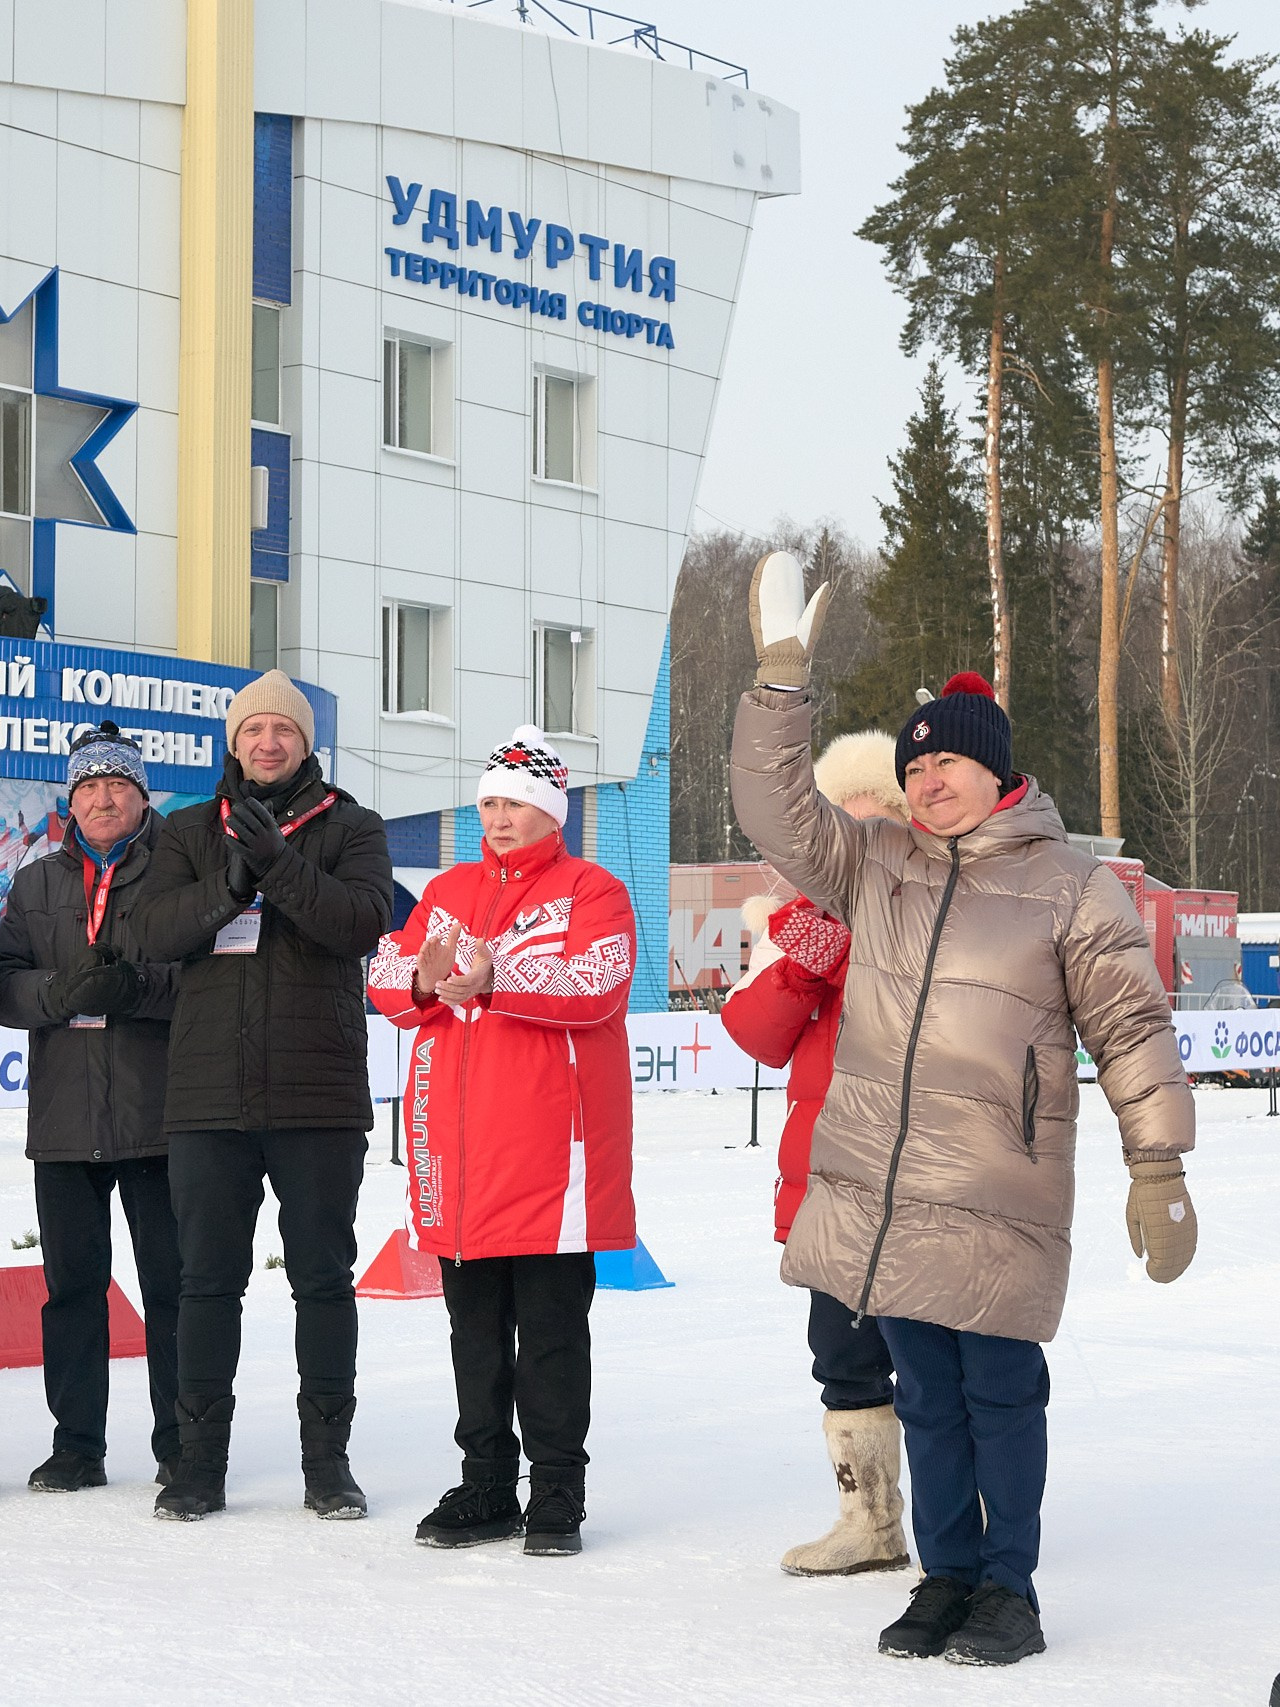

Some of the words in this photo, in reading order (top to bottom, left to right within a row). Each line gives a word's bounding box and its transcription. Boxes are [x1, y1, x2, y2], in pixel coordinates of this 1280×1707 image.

[385, 174, 676, 302] УДМУРТИЯ
[384, 246, 567, 320] ТЕРРИТОРИЯ
[577, 300, 675, 350] СПОРТА
[62, 667, 236, 720] КОМПЛЕКС
[413, 1036, 436, 1227] UDMURTIA
